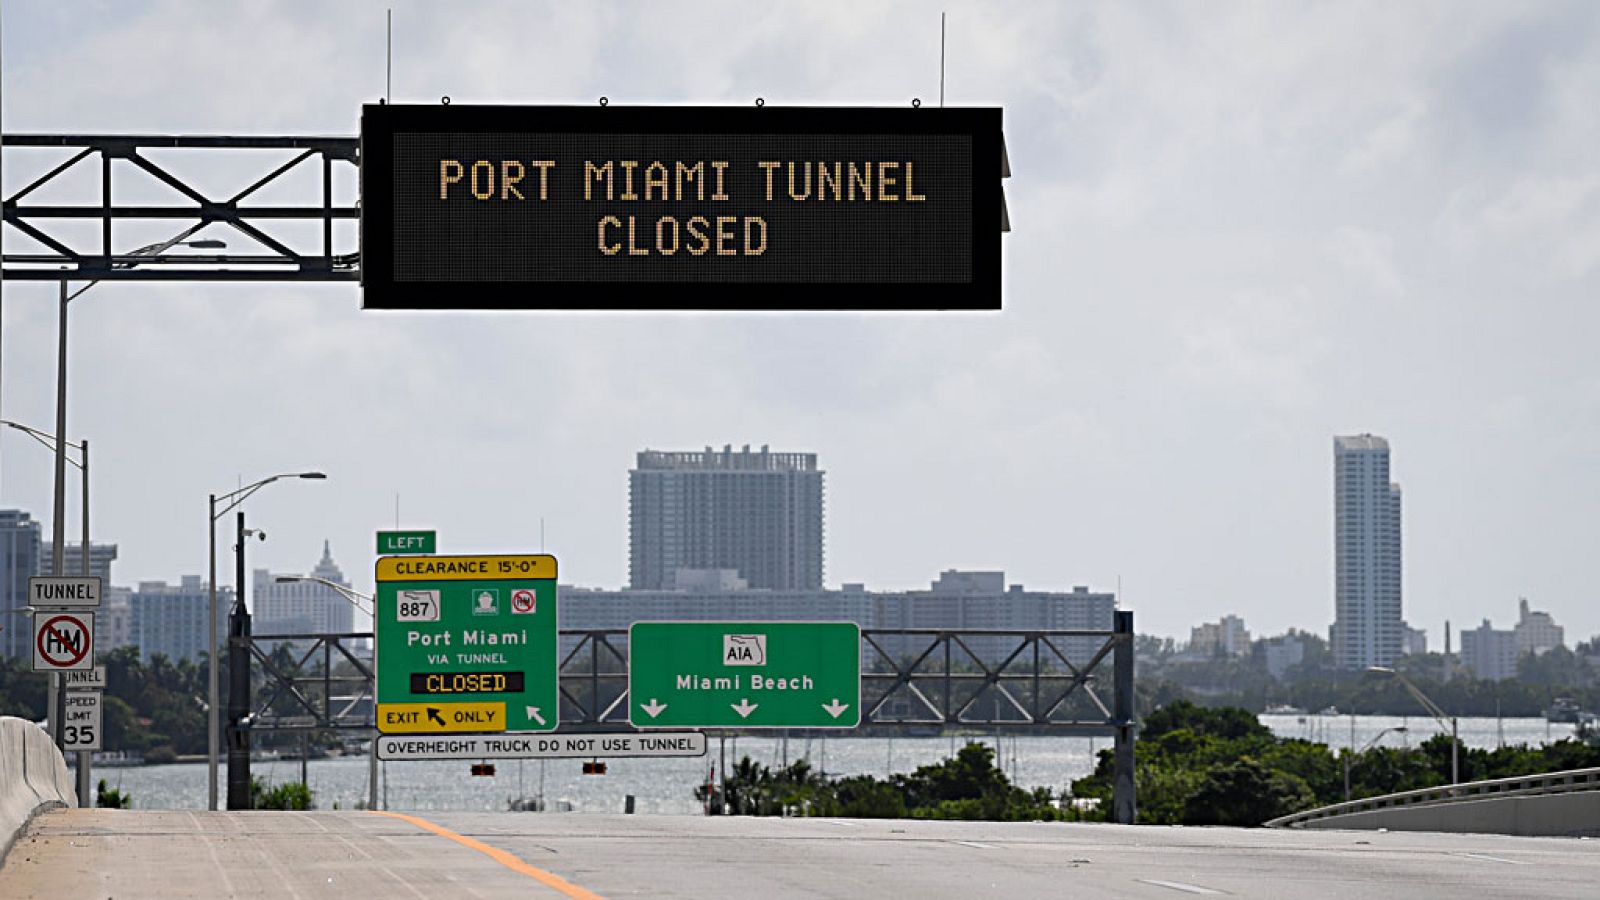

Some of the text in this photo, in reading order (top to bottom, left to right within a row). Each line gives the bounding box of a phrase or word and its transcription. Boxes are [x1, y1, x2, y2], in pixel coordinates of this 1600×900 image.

[440, 160, 926, 200] PORT MIAMI TUNNEL
[598, 216, 768, 255] CLOSED
[388, 537, 425, 549] LEFT
[397, 562, 488, 574] CLEARANCE
[35, 584, 95, 599] TUNNEL
[400, 603, 429, 616] 887
[47, 629, 80, 654] HM
[408, 631, 528, 646] Port Miami
[428, 654, 507, 665] VIA TUNNEL
[727, 647, 752, 660] A1A
[426, 674, 506, 692] CLOSED
[676, 675, 813, 689] Miami Beach
[67, 711, 91, 720] LIMIT
[387, 711, 496, 724] EXIT ONLY
[64, 726, 94, 744] 35
[387, 739, 696, 753] OVERHEIGHT TRUCK DO NOT USE TUNNEL
